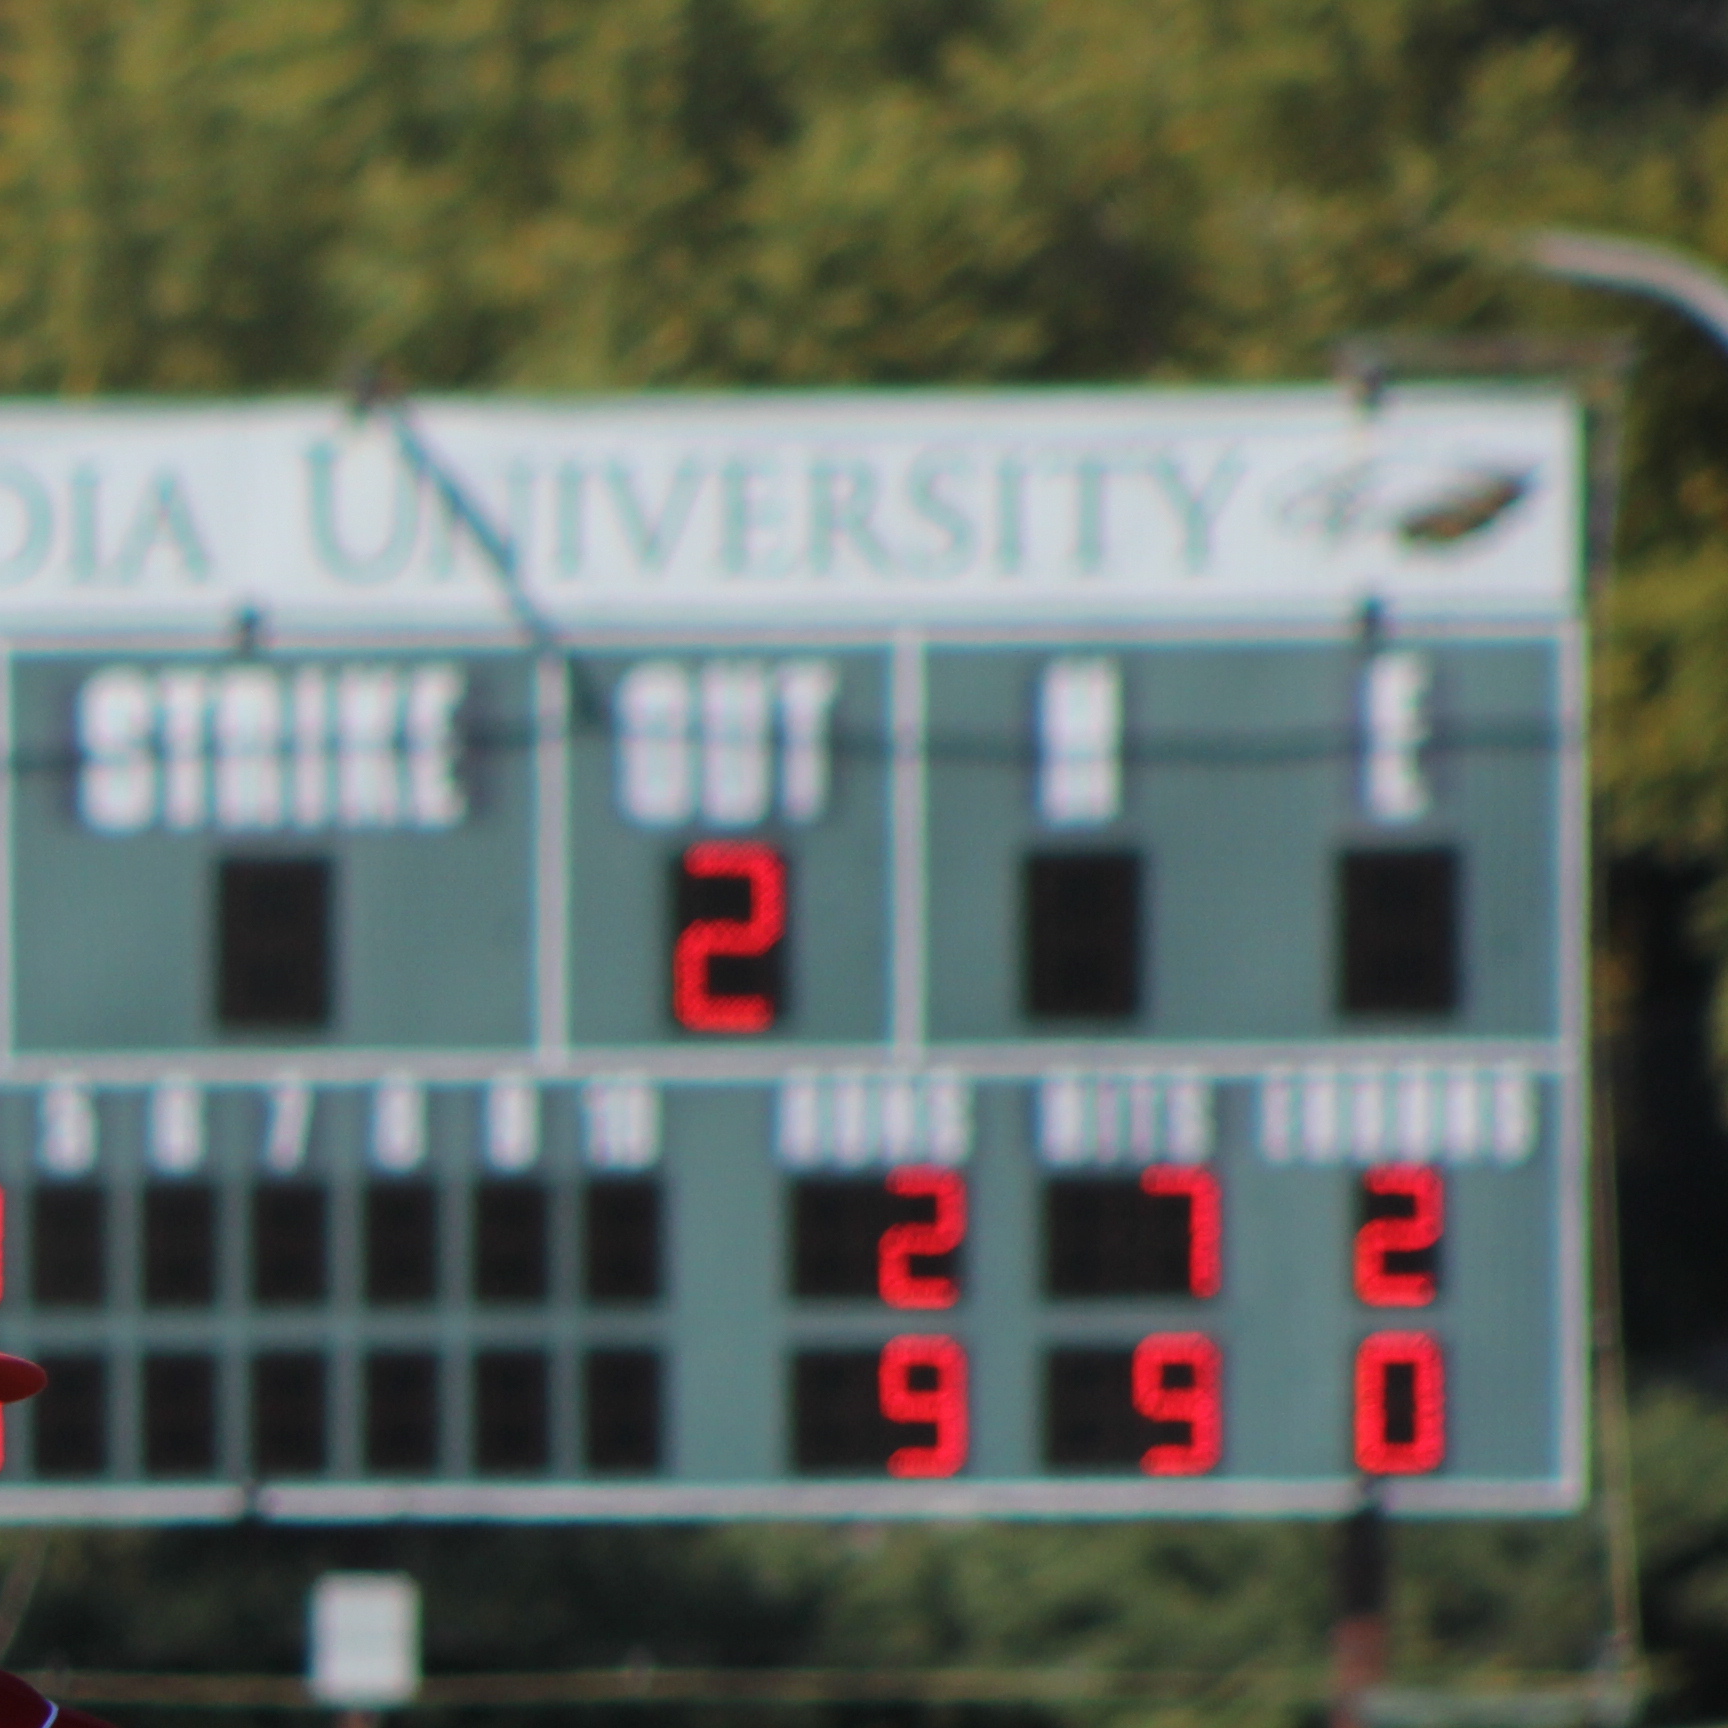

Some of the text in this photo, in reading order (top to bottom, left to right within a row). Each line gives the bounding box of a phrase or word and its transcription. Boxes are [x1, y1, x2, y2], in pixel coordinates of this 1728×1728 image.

[304, 436, 1252, 586] UNIVERSITY
[78, 662, 468, 832] STRIKE
[617, 658, 840, 825] OUT
[673, 842, 786, 1034] 2
[263, 1072, 313, 1172] 7
[878, 1164, 968, 1310] 2
[1140, 1164, 1222, 1299] 7
[1354, 1164, 1445, 1307] 2
[878, 1333, 969, 1477] 9
[1131, 1331, 1223, 1476] 9
[1355, 1330, 1445, 1476] 0
